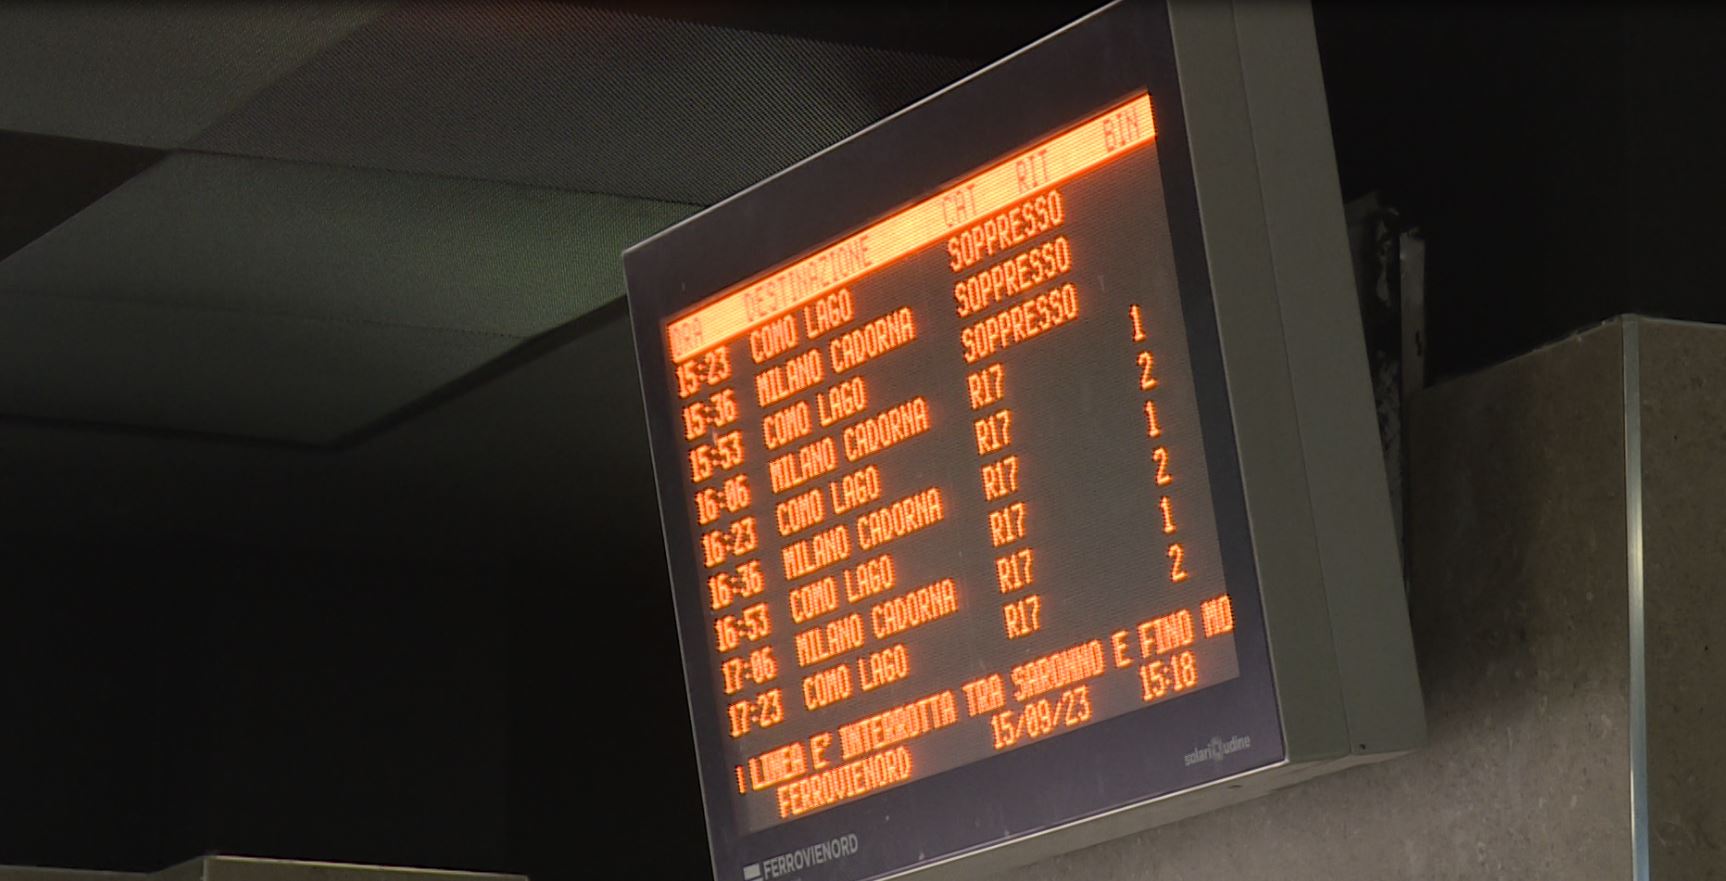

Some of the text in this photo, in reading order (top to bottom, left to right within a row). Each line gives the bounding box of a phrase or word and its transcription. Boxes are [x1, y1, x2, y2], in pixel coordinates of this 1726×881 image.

[670, 104, 1142, 358] ORA DESTINAZIONE CAT RIT BIN
[675, 188, 1063, 398] 15:23 COMO LAGO SOPPRESSO
[682, 234, 1070, 440] 15:36 MILANO CADORNA SOPPRESSO
[688, 281, 1077, 482] 15:53 COMO LAGO SOPPRESSO
[695, 304, 1143, 524] 16:06 MILANO CADORNA R17 1
[701, 350, 1155, 567] 16:23 COMO LAGO R17 2
[708, 399, 1159, 610] 16:36 MILANO CADORNA R17 1
[714, 446, 1170, 652] 16:53 COMO LAGO R17 2
[721, 496, 1174, 694] 17:06 MILANO CADORNA R17 1
[727, 542, 1186, 737] 17:23 COMO LAGO R17 2
[748, 741, 806, 791] LINEA
[837, 689, 957, 760] INTERROTTA
[961, 673, 1005, 717] TRA
[1010, 638, 1105, 702] SARONNO
[1111, 629, 1132, 668] E
[1137, 608, 1194, 659] FINO
[776, 743, 913, 819] FERROVIENORD
[990, 684, 1091, 749] 15/09/23
[1139, 649, 1197, 701] 15:18
[762, 833, 858, 880] FERROVIENORD
